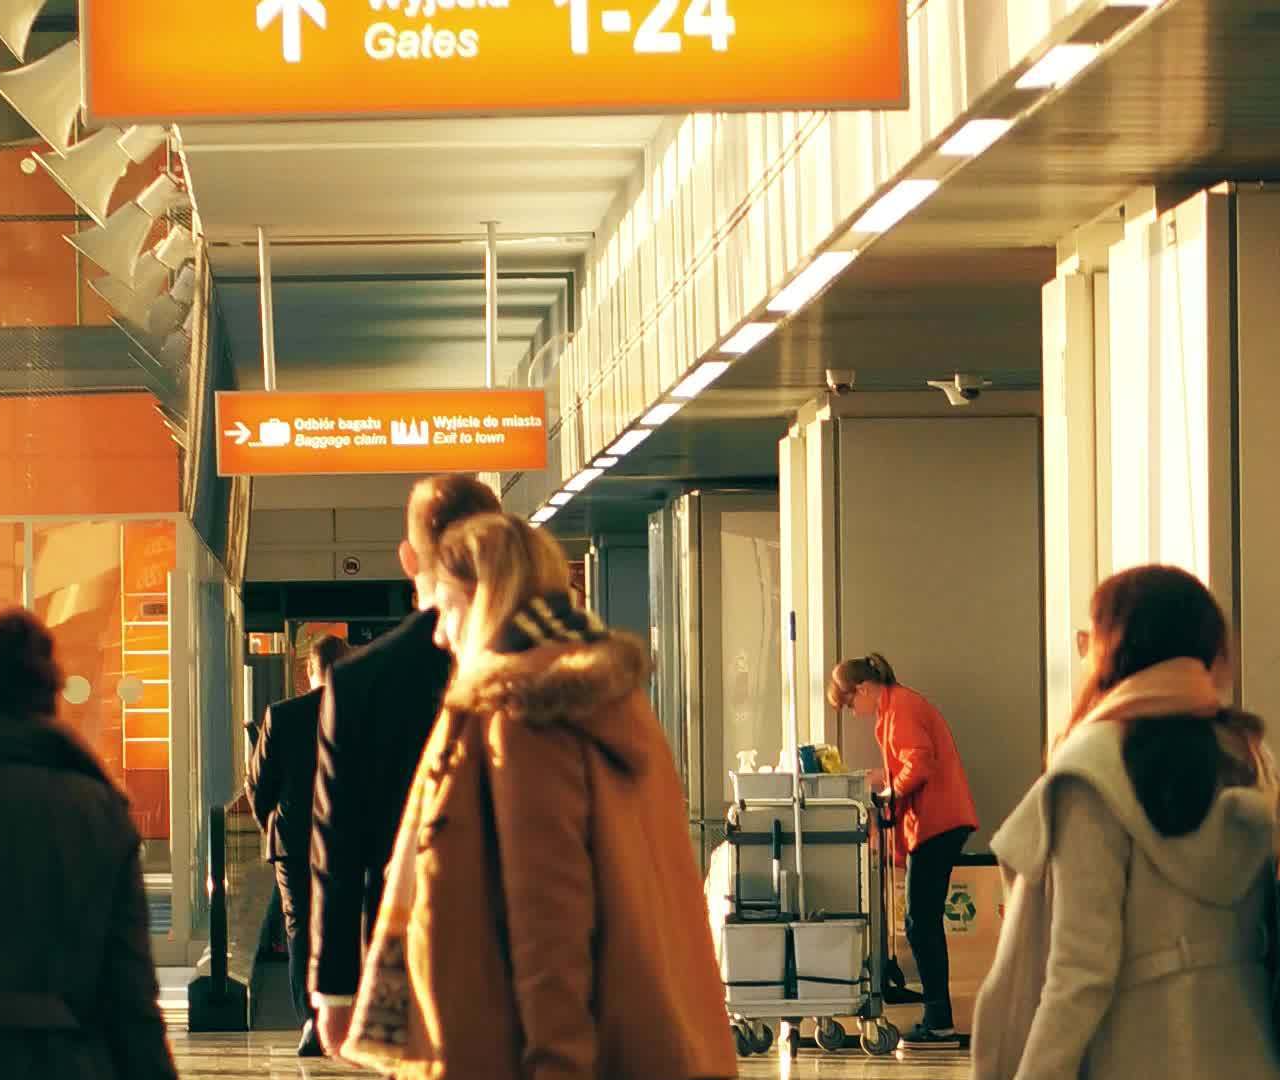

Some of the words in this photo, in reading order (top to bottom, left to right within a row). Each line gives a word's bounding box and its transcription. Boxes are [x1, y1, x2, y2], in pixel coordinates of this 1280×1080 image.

[553, 0, 736, 54] 1-24
[364, 22, 479, 60] Gates
[483, 415, 499, 427] do
[502, 415, 542, 427] miasta
[295, 433, 351, 448] Baggage
[353, 432, 387, 445] claim
[433, 431, 457, 444] Exit
[459, 432, 472, 444] to
[475, 432, 505, 444] town
